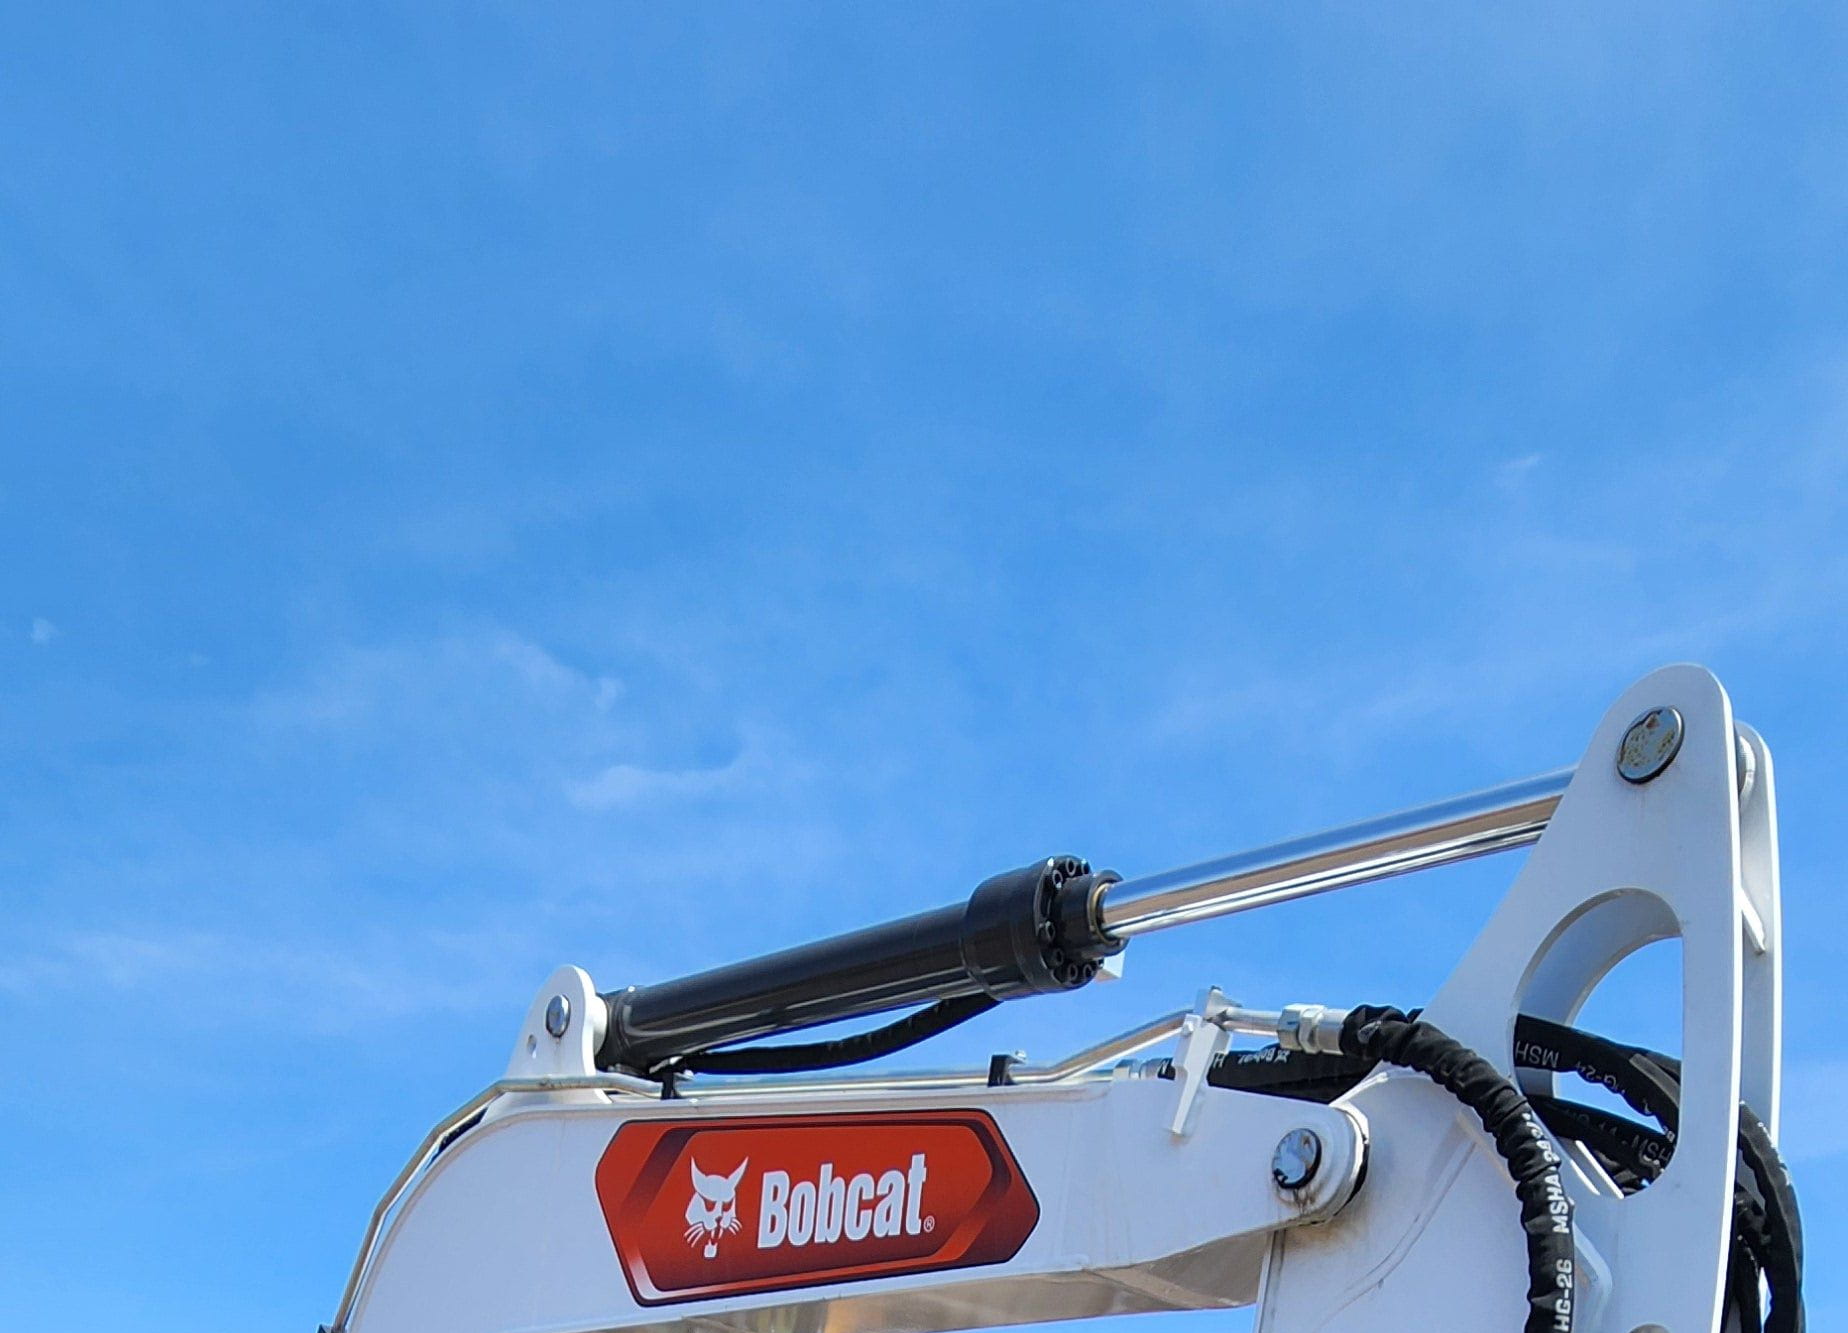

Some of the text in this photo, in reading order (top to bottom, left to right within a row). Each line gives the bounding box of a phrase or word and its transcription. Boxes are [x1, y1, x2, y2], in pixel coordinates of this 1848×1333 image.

[757, 1152, 927, 1249] Bobcat
[1544, 1174, 1573, 1332] HG-26 MSHA
